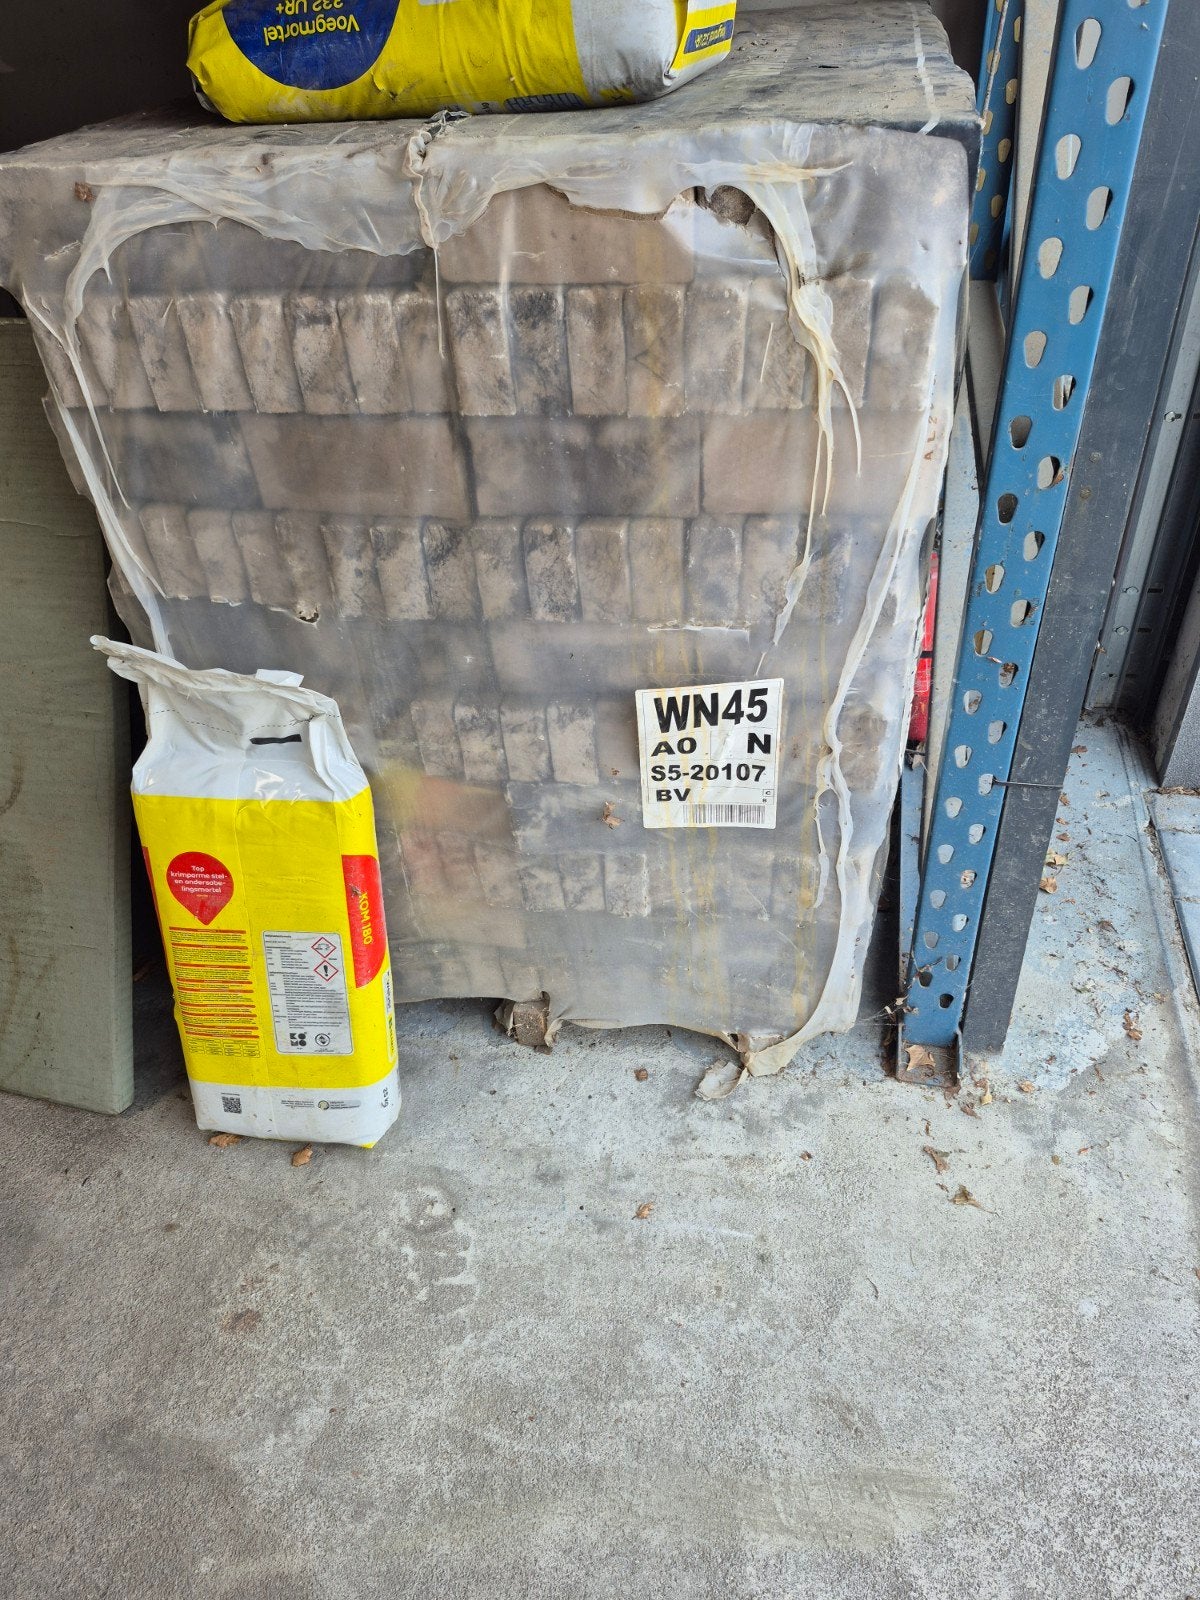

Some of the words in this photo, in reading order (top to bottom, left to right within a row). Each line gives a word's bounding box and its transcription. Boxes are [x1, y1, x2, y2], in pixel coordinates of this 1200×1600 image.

[263, 13, 361, 46] Voegmortel
[653, 687, 769, 734] WN45
[747, 732, 772, 754] N
[650, 763, 766, 782] S5-20107
[655, 787, 691, 802] BV
[170, 870, 210, 879] krimparme
[358, 892, 371, 923] KOM
[361, 924, 374, 945] 180
[380, 1098, 390, 1108] kg
